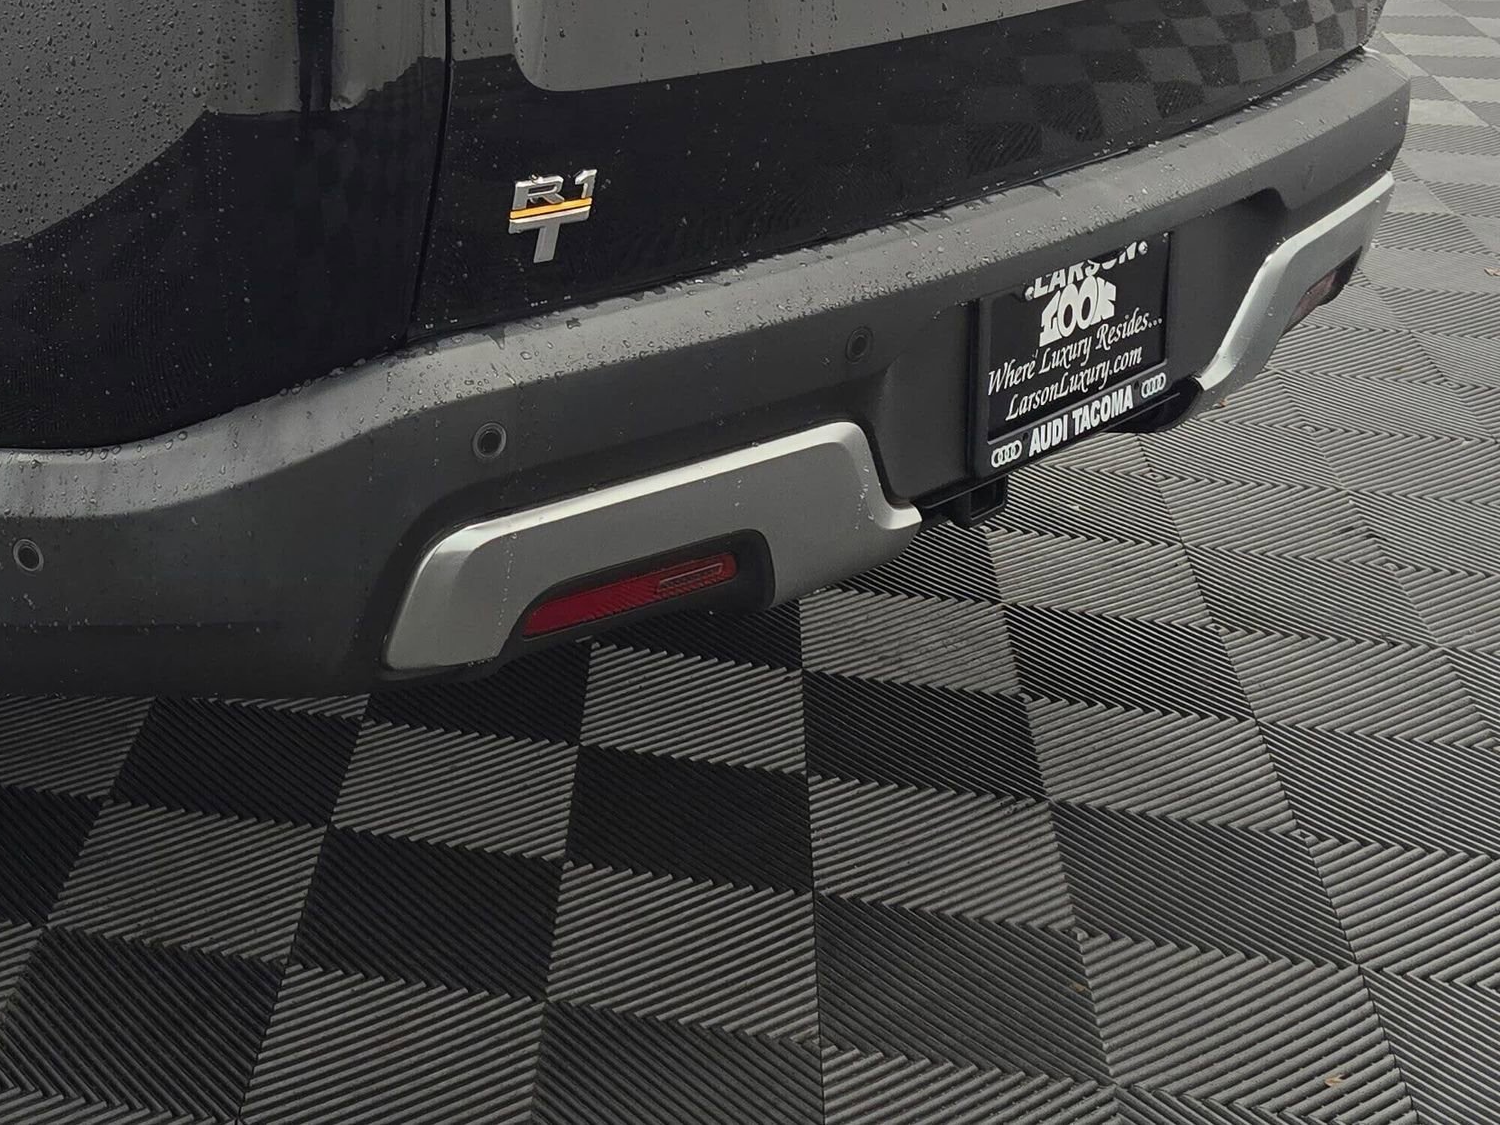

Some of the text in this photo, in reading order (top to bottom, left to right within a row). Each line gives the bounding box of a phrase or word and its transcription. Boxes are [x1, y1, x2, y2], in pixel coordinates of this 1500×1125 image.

[988, 356, 1036, 396] Where
[1038, 334, 1093, 375] Luxury
[1005, 346, 1143, 421] LarsonLuxury.com
[1028, 384, 1134, 457] AUDI TACOMA
